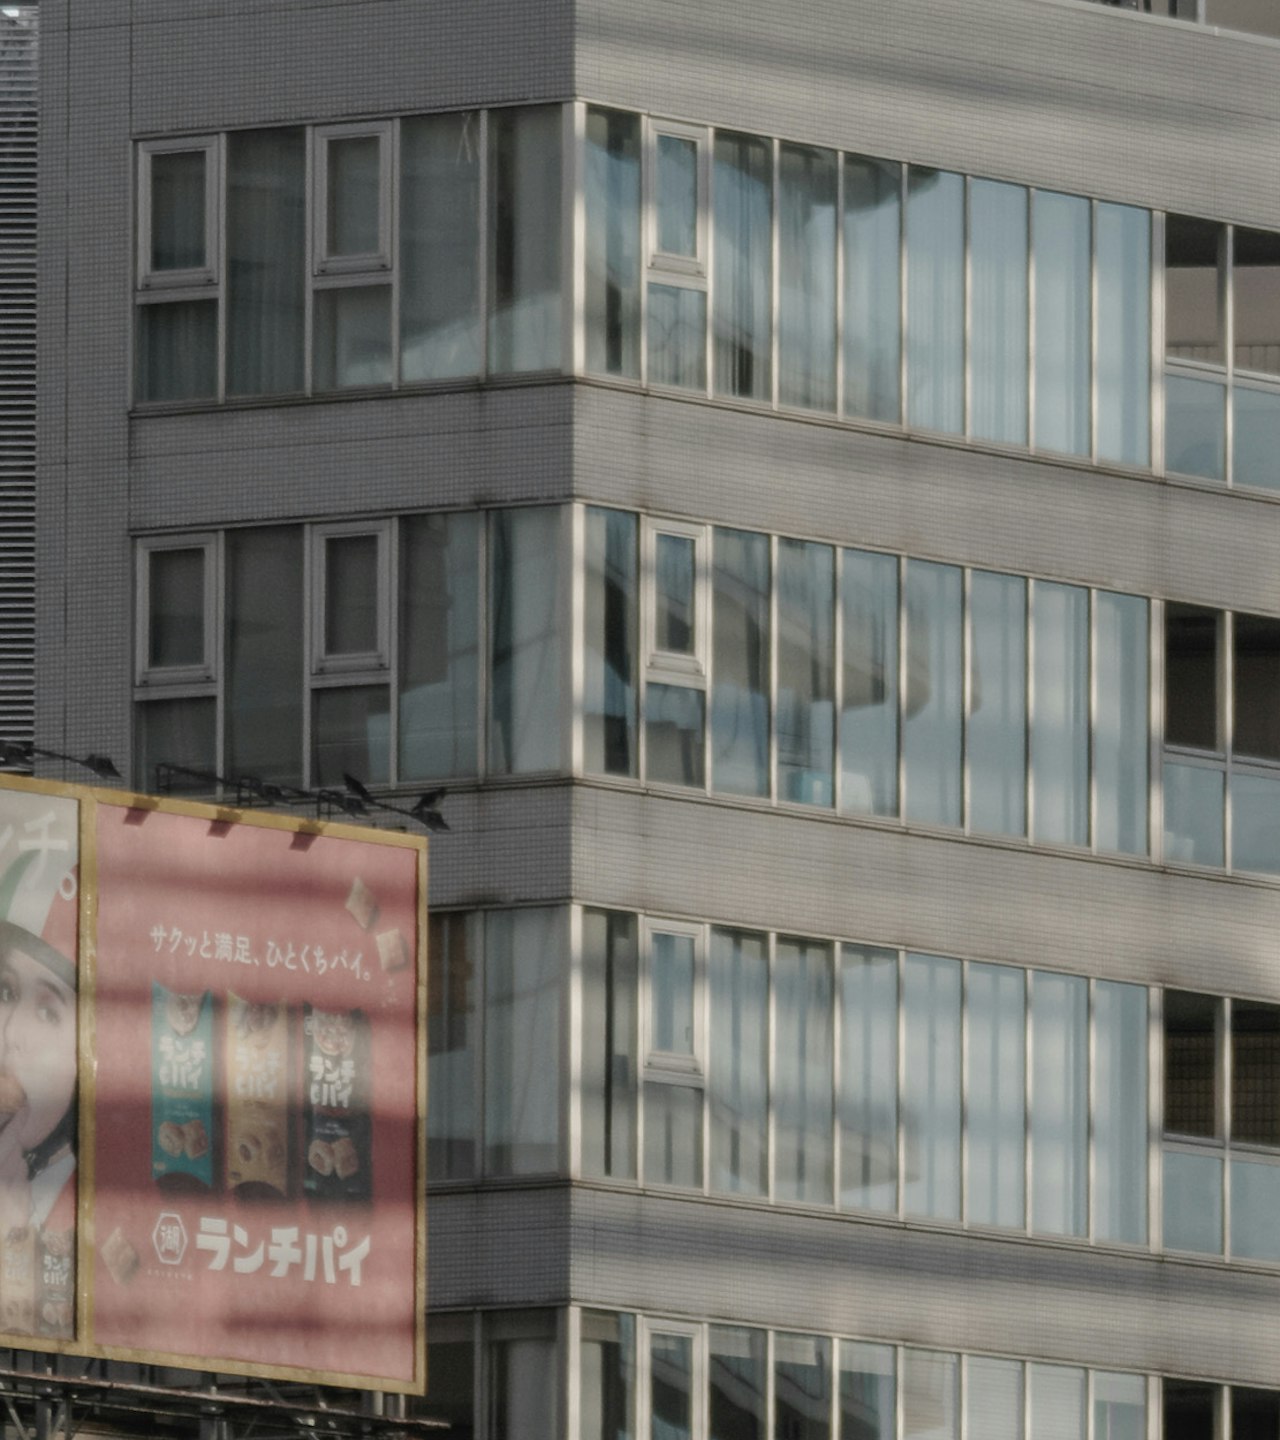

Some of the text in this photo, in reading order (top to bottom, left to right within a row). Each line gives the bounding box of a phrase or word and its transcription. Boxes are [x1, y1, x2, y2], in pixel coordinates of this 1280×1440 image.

[196, 1216, 370, 1287] ランチパイ
